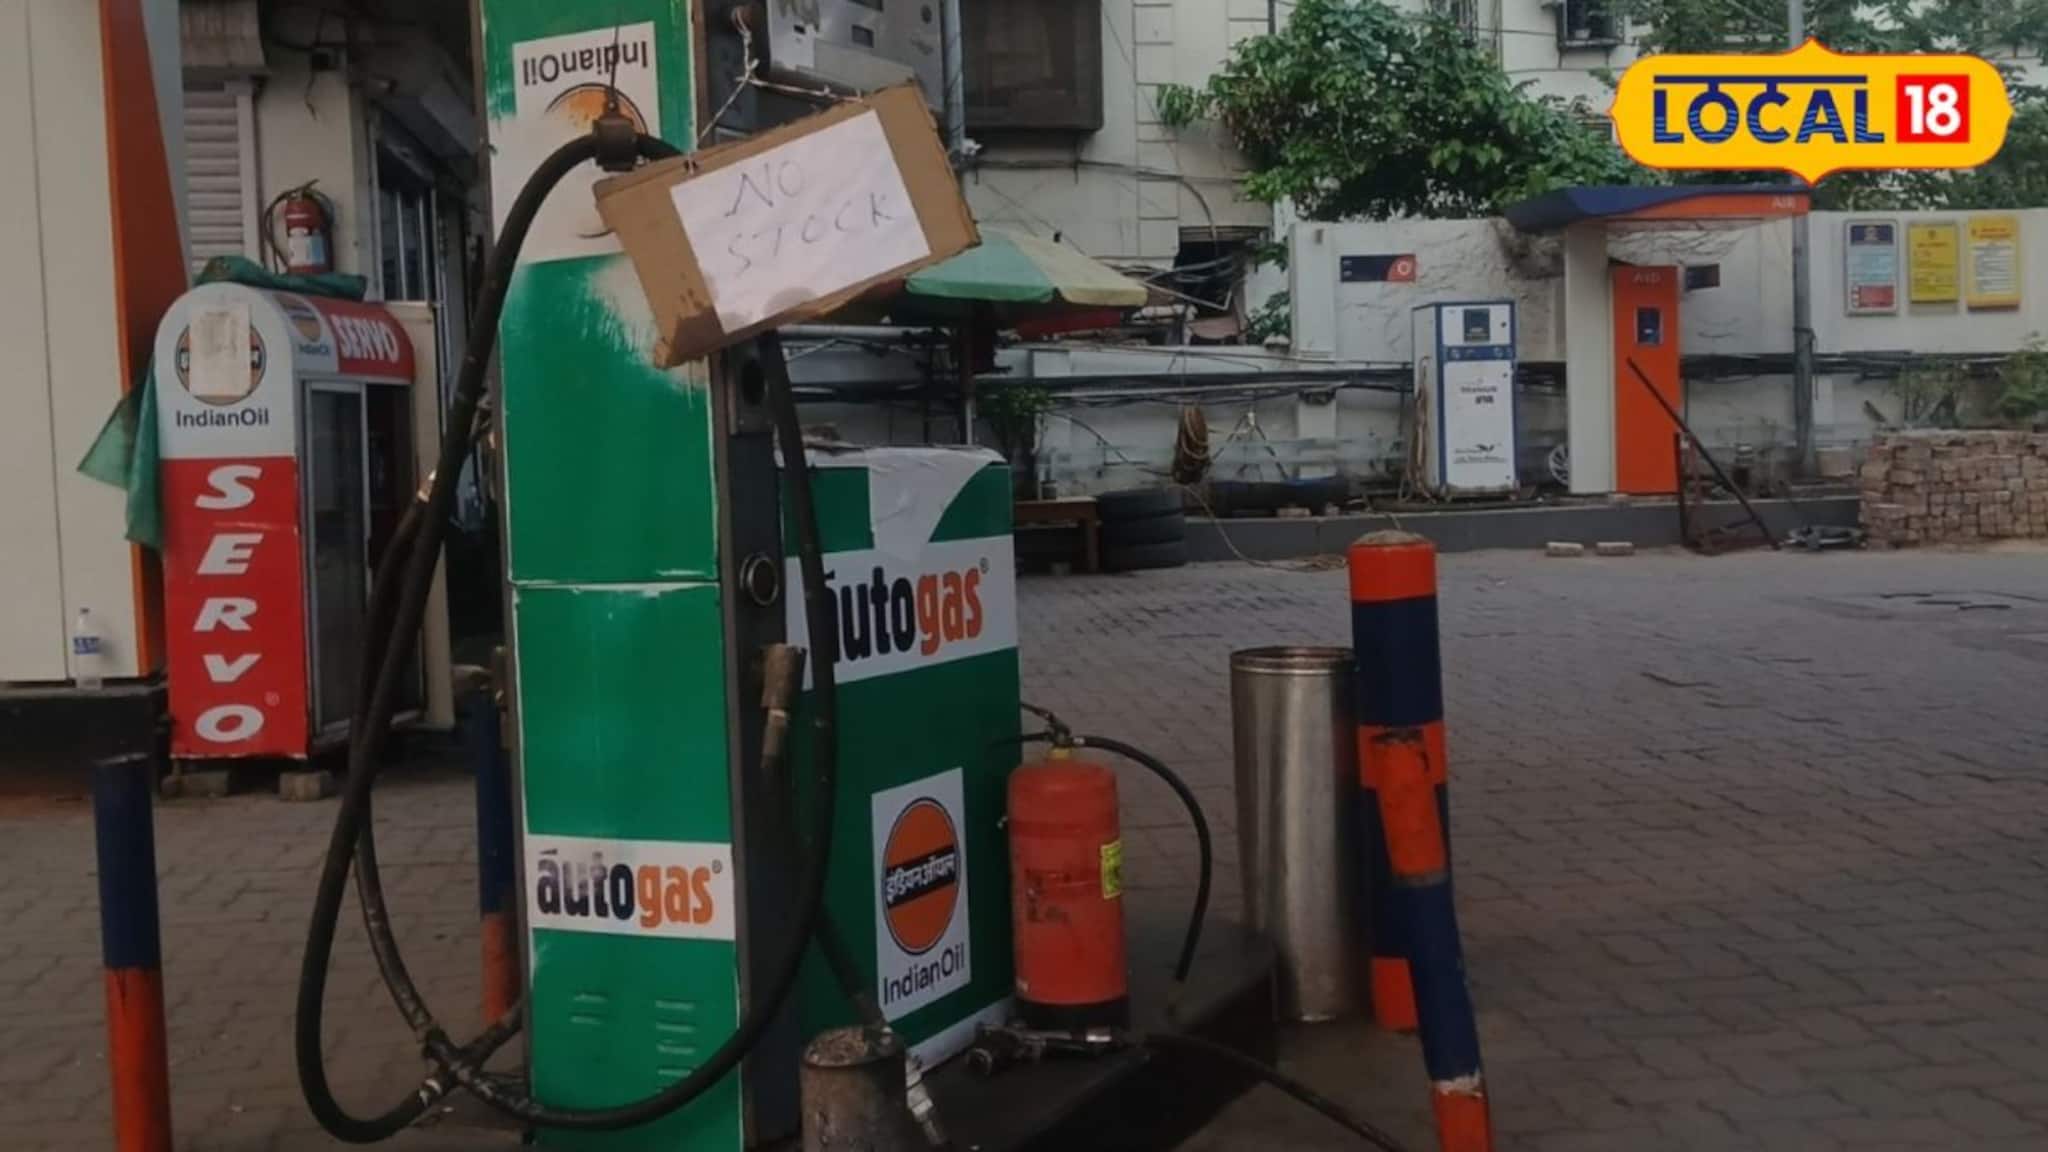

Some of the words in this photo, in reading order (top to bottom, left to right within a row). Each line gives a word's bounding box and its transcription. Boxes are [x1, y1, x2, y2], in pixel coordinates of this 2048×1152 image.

[522, 41, 648, 86] IndianOil
[724, 159, 801, 218] NO
[727, 191, 893, 279] STOCK
[329, 313, 399, 364] SERVO
[176, 408, 269, 427] IndianOil
[194, 464, 265, 743] SERVO
[884, 943, 965, 1005] IndianOil
